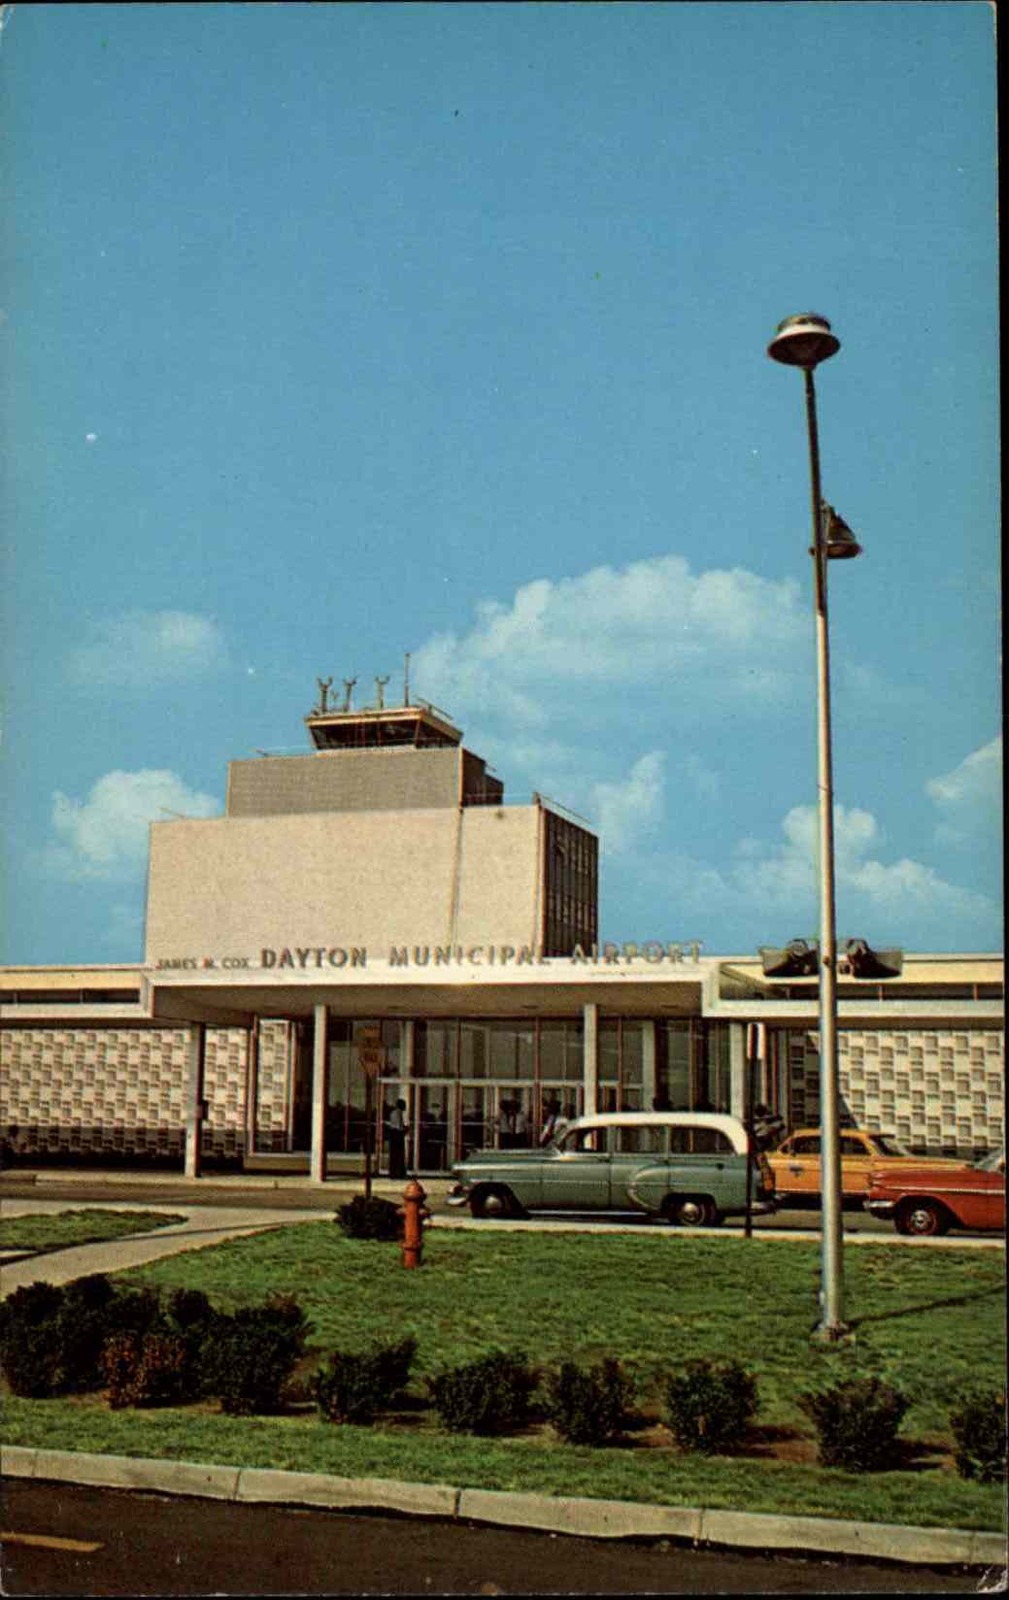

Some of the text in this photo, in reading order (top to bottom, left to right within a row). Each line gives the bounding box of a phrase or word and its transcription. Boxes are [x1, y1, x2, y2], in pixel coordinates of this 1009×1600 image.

[221, 957, 250, 970] COX
[260, 947, 367, 969] DAYTON
[389, 945, 552, 967] MUNICIPAL
[570, 939, 704, 965] AIRPORT
